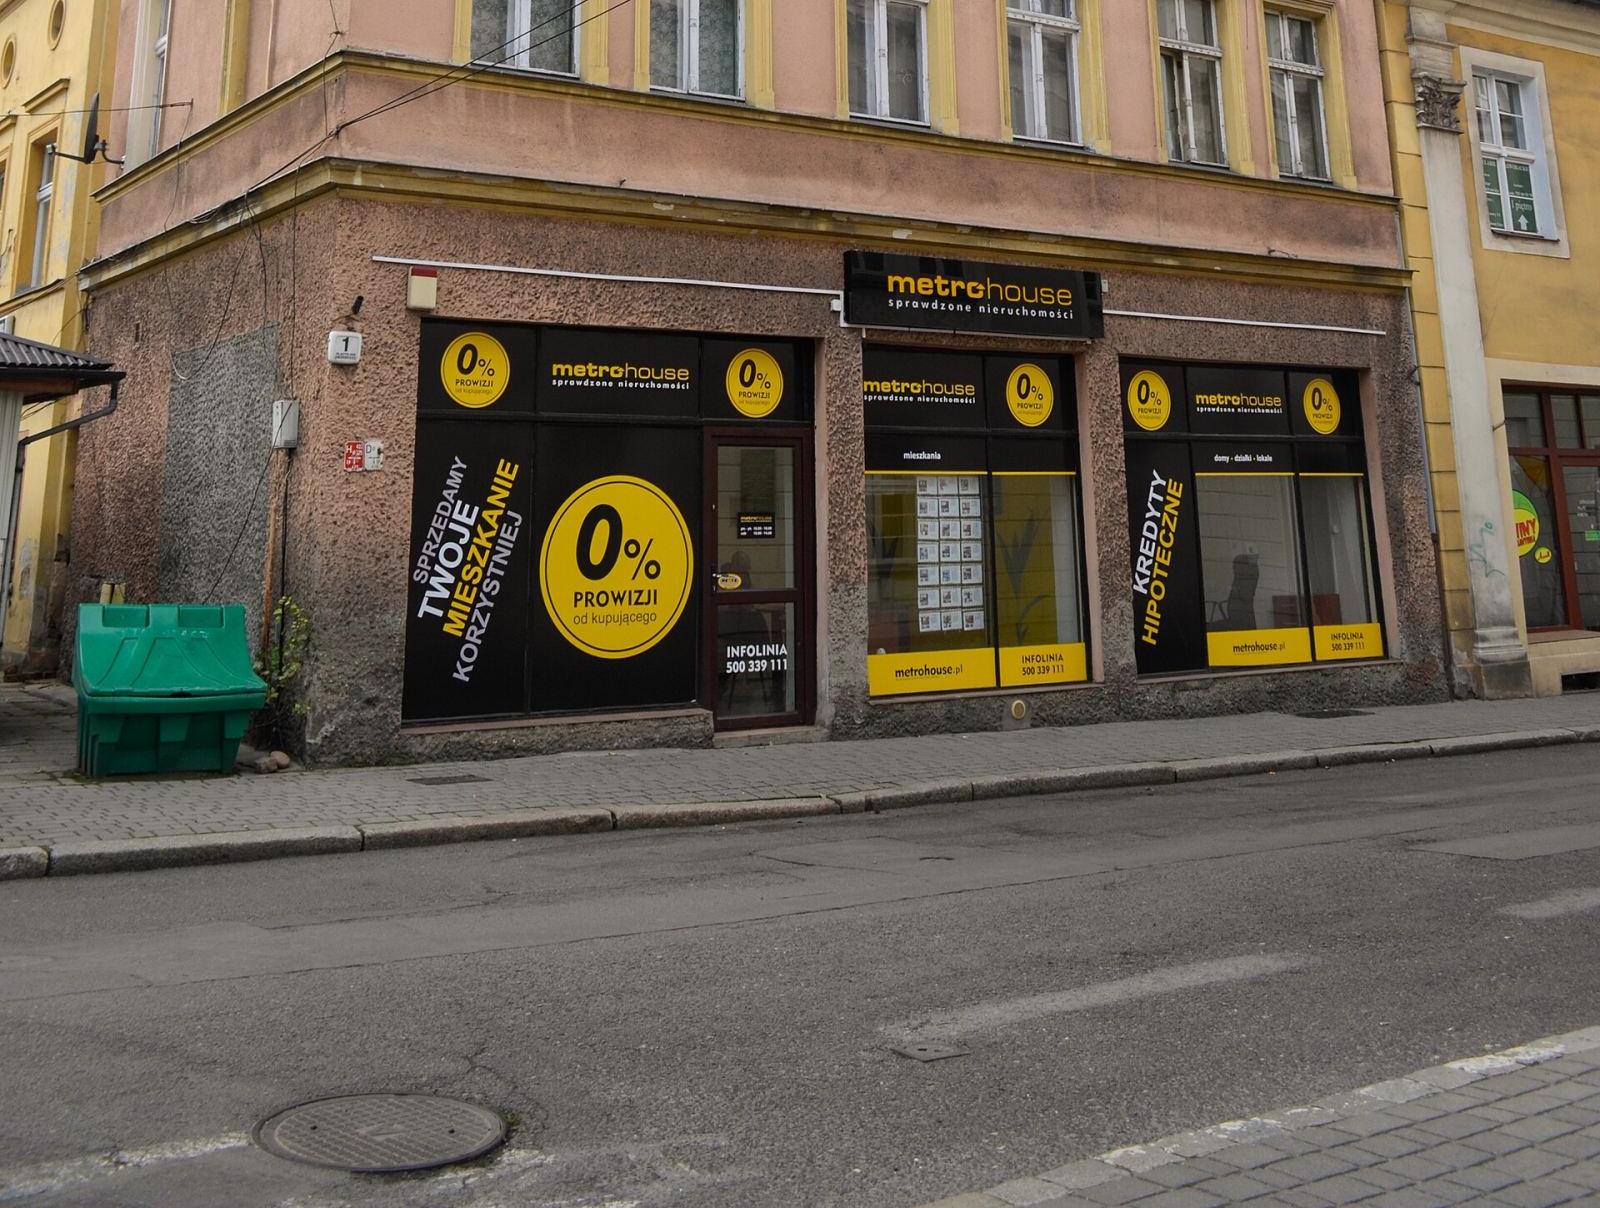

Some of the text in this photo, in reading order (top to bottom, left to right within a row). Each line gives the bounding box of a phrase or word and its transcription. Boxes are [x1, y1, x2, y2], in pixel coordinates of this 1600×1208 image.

[887, 274, 1073, 306] metrohouse
[888, 297, 1074, 320] sprawdzone nieruchomości
[342, 336, 350, 352] 1
[456, 343, 495, 377] 0%
[552, 362, 690, 381] metrohouse
[739, 358, 771, 389] 0%
[455, 379, 494, 387] PROWIZJI
[552, 379, 690, 390] sprawdzone nieruchomości
[863, 379, 976, 396] metrohouse
[1016, 373, 1043, 400] 0%
[738, 391, 771, 399] PROWIZJI
[864, 394, 976, 404] sprawdzone nieruchomości
[1137, 379, 1161, 405] 0%
[1195, 392, 1282, 407] metrohouse
[1311, 387, 1333, 411] 0%
[903, 451, 942, 460] mieszkania
[1214, 453, 1230, 464] domy
[1256, 454, 1273, 462] lokale
[412, 455, 468, 584] SPRZEDAMY
[1132, 468, 1167, 595] KREDYTY
[442, 458, 520, 638] MIESZKANIE
[576, 503, 662, 581] 0%
[417, 499, 480, 619] TWOJE
[1141, 477, 1184, 646] HIPOTECZNE
[452, 510, 523, 682] KORZYSTNIEJ
[573, 589, 658, 608] PROWIZJI
[573, 611, 657, 627] od kupującego
[1331, 632, 1364, 641] INFOLINIA
[727, 643, 788, 658] INFOLINIA
[1233, 642, 1286, 653] metrohouse.pl
[1331, 643, 1342, 651] 500
[1343, 642, 1354, 651] 339
[726, 658, 788, 674] 500 339 111
[1021, 653, 1064, 664] INFOLINIA
[895, 664, 963, 678] metrohouse.pl
[1022, 664, 1064, 676] 500 339 111
